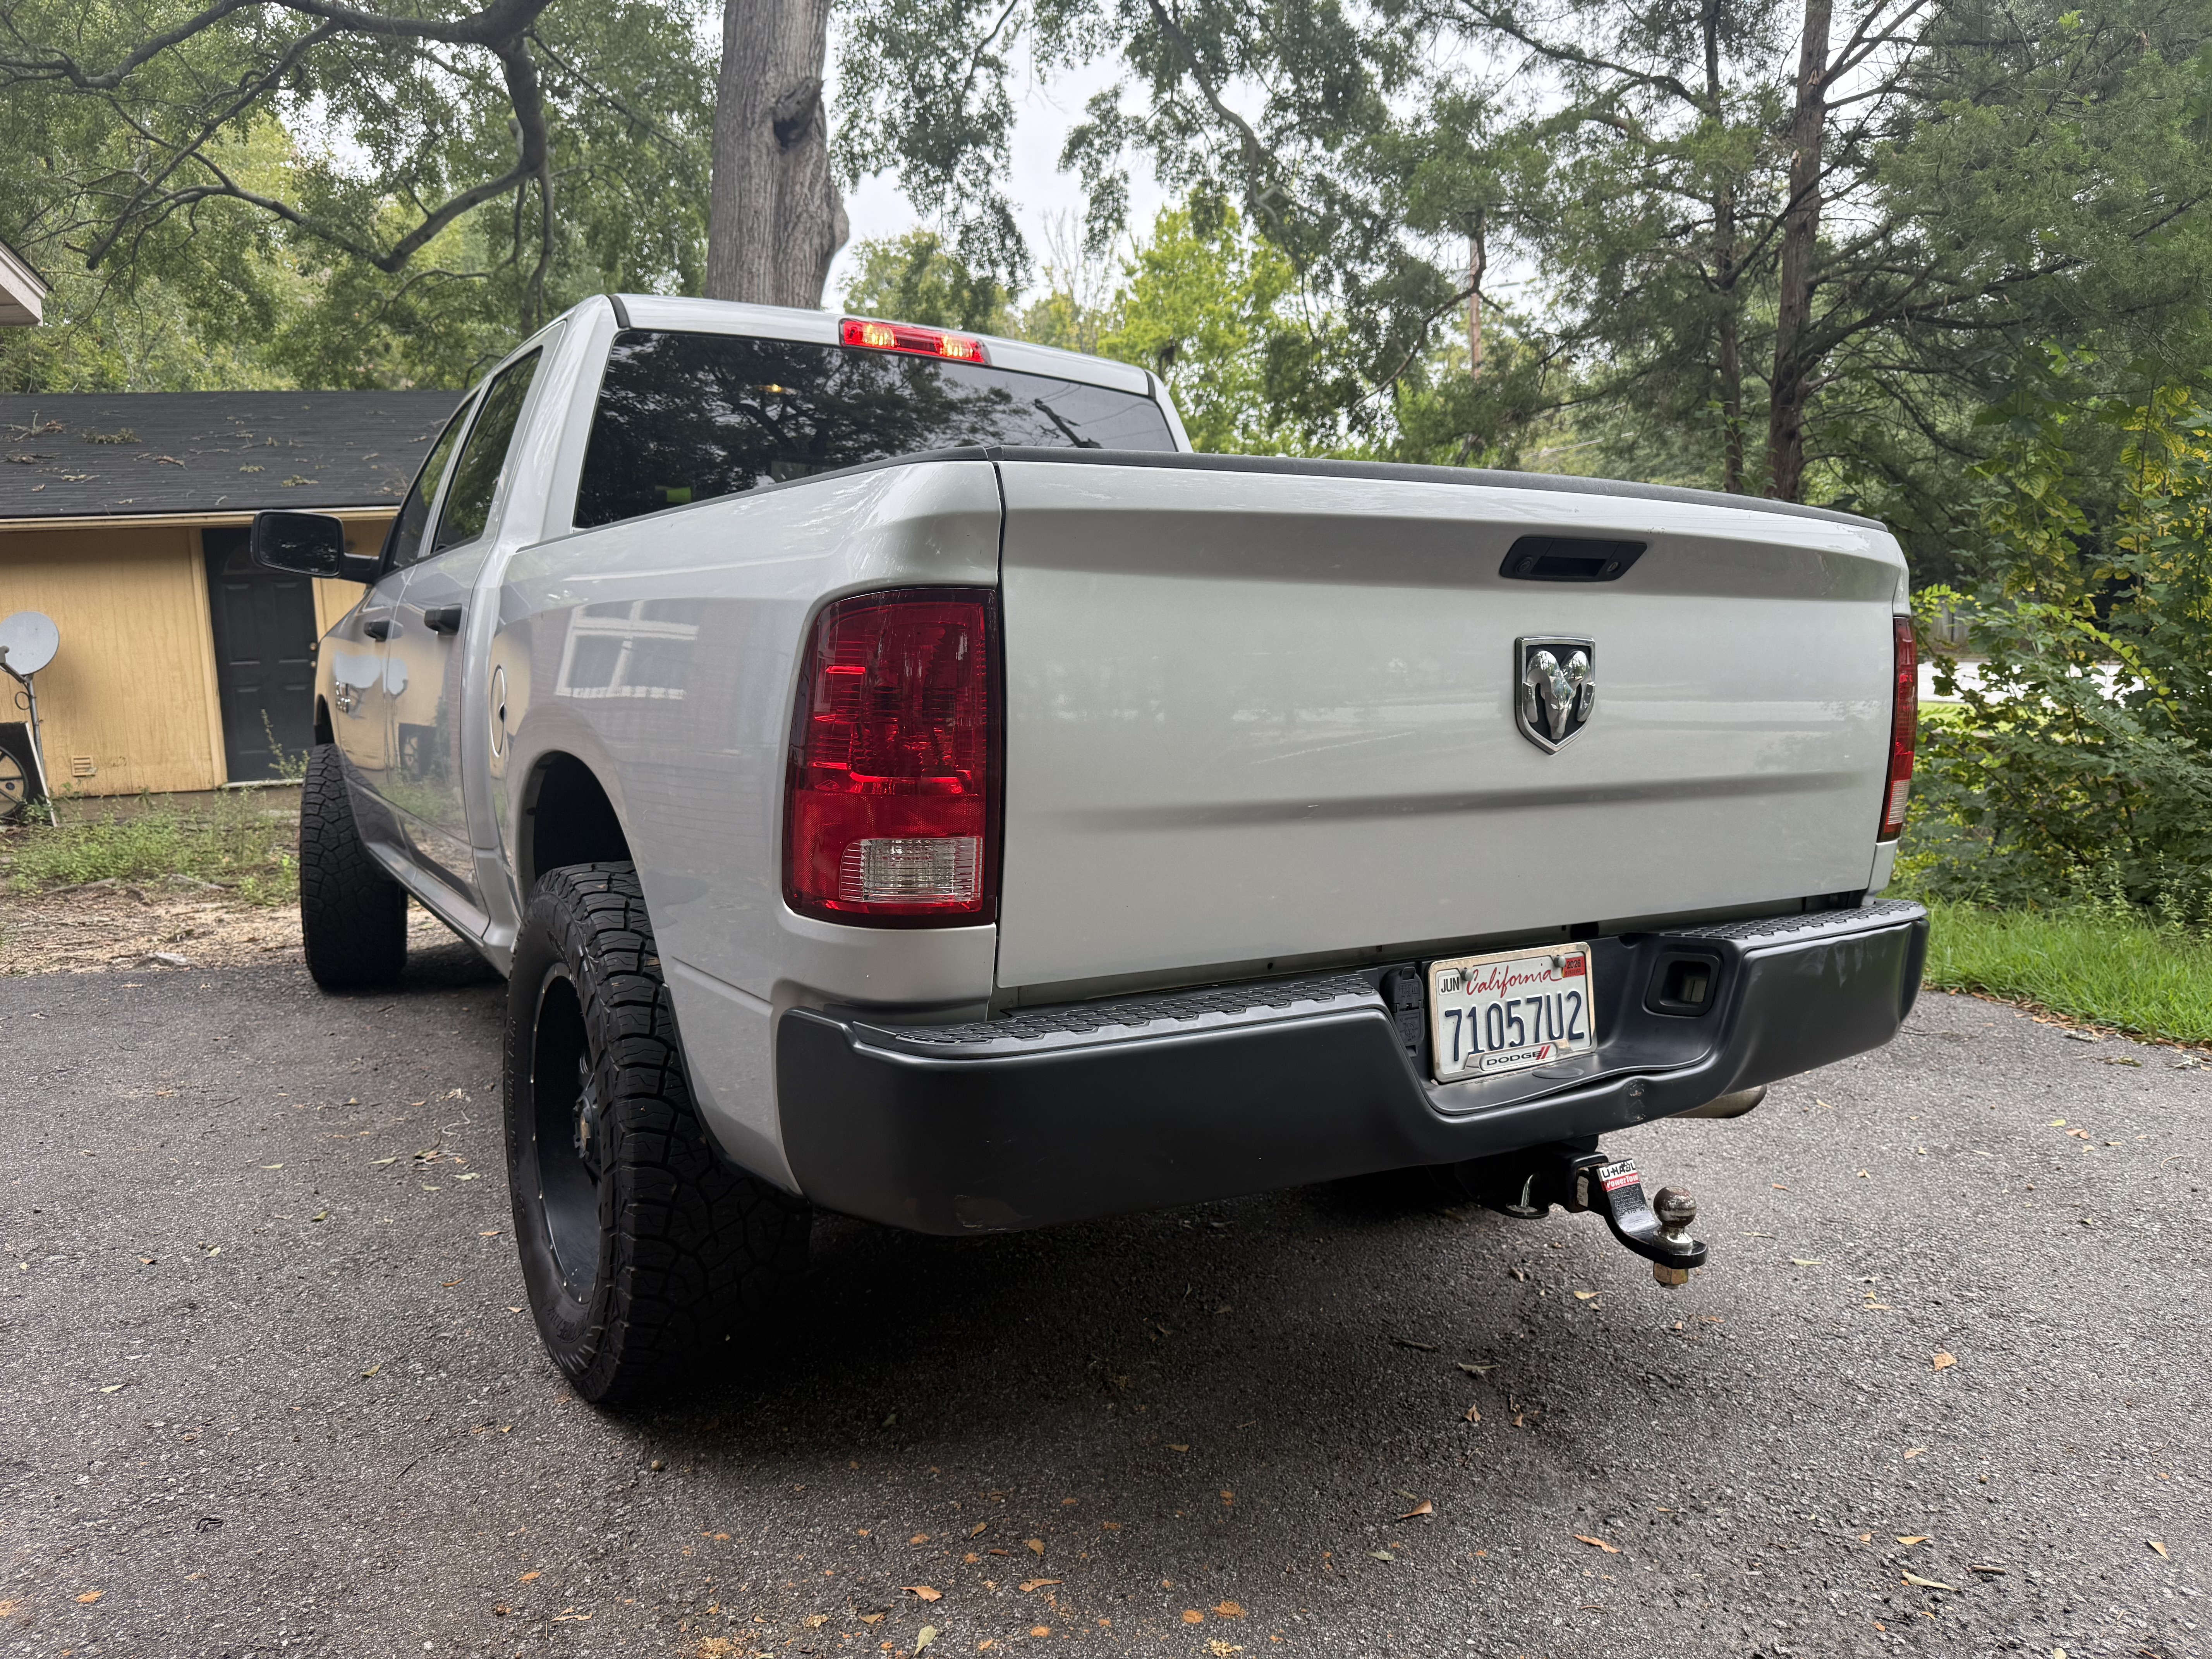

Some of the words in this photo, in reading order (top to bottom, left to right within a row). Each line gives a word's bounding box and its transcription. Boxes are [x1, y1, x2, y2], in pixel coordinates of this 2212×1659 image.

[1567, 959, 1581, 969] 2026
[1441, 976, 1460, 993] JUN
[1466, 963, 1563, 998] California
[1444, 990, 1585, 1061] 71057U2
[1487, 1050, 1542, 1066] DODGE
